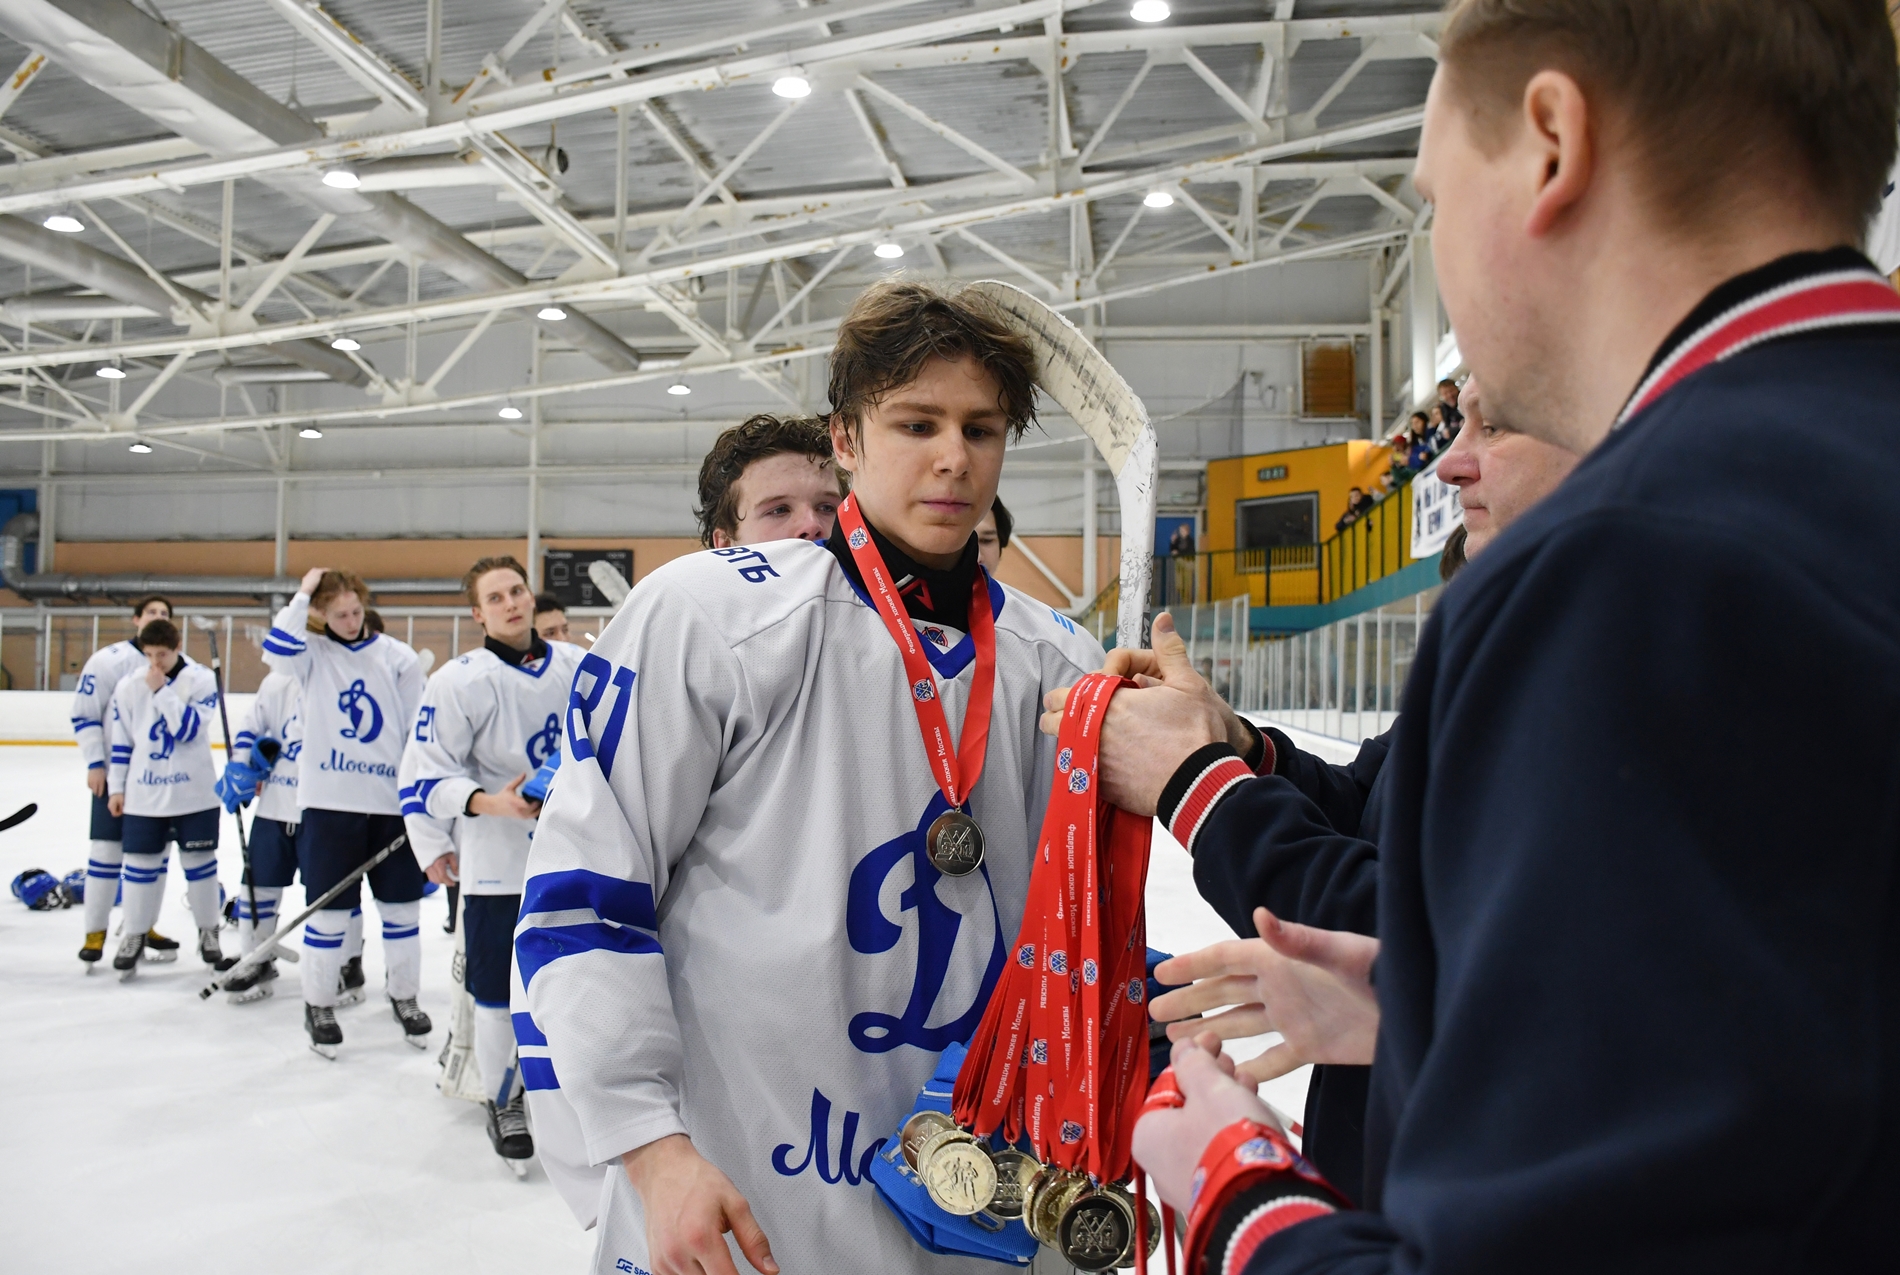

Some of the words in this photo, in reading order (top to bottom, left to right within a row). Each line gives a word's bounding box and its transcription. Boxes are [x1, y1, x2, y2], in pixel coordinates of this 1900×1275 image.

[711, 547, 781, 583] ВТБ
[872, 566, 888, 594] Москвы
[885, 594, 899, 616] хоккея
[896, 618, 916, 655] Федерация
[415, 705, 436, 743] 21
[1082, 704, 1098, 738] Москвы
[934, 726, 946, 757] Москвы
[137, 768, 191, 786] Москва
[320, 748, 397, 778] Москва
[942, 758, 952, 782] хоккея
[1067, 823, 1077, 870] Федерация
[1069, 904, 1078, 938] Москвы
[1011, 998, 1026, 1031] Москвы
[1061, 1005, 1071, 1040] Москвы
[1006, 1033, 1018, 1060] хоккея
[992, 1062, 1011, 1106] Федерация
[1033, 1094, 1044, 1141] Федерация
